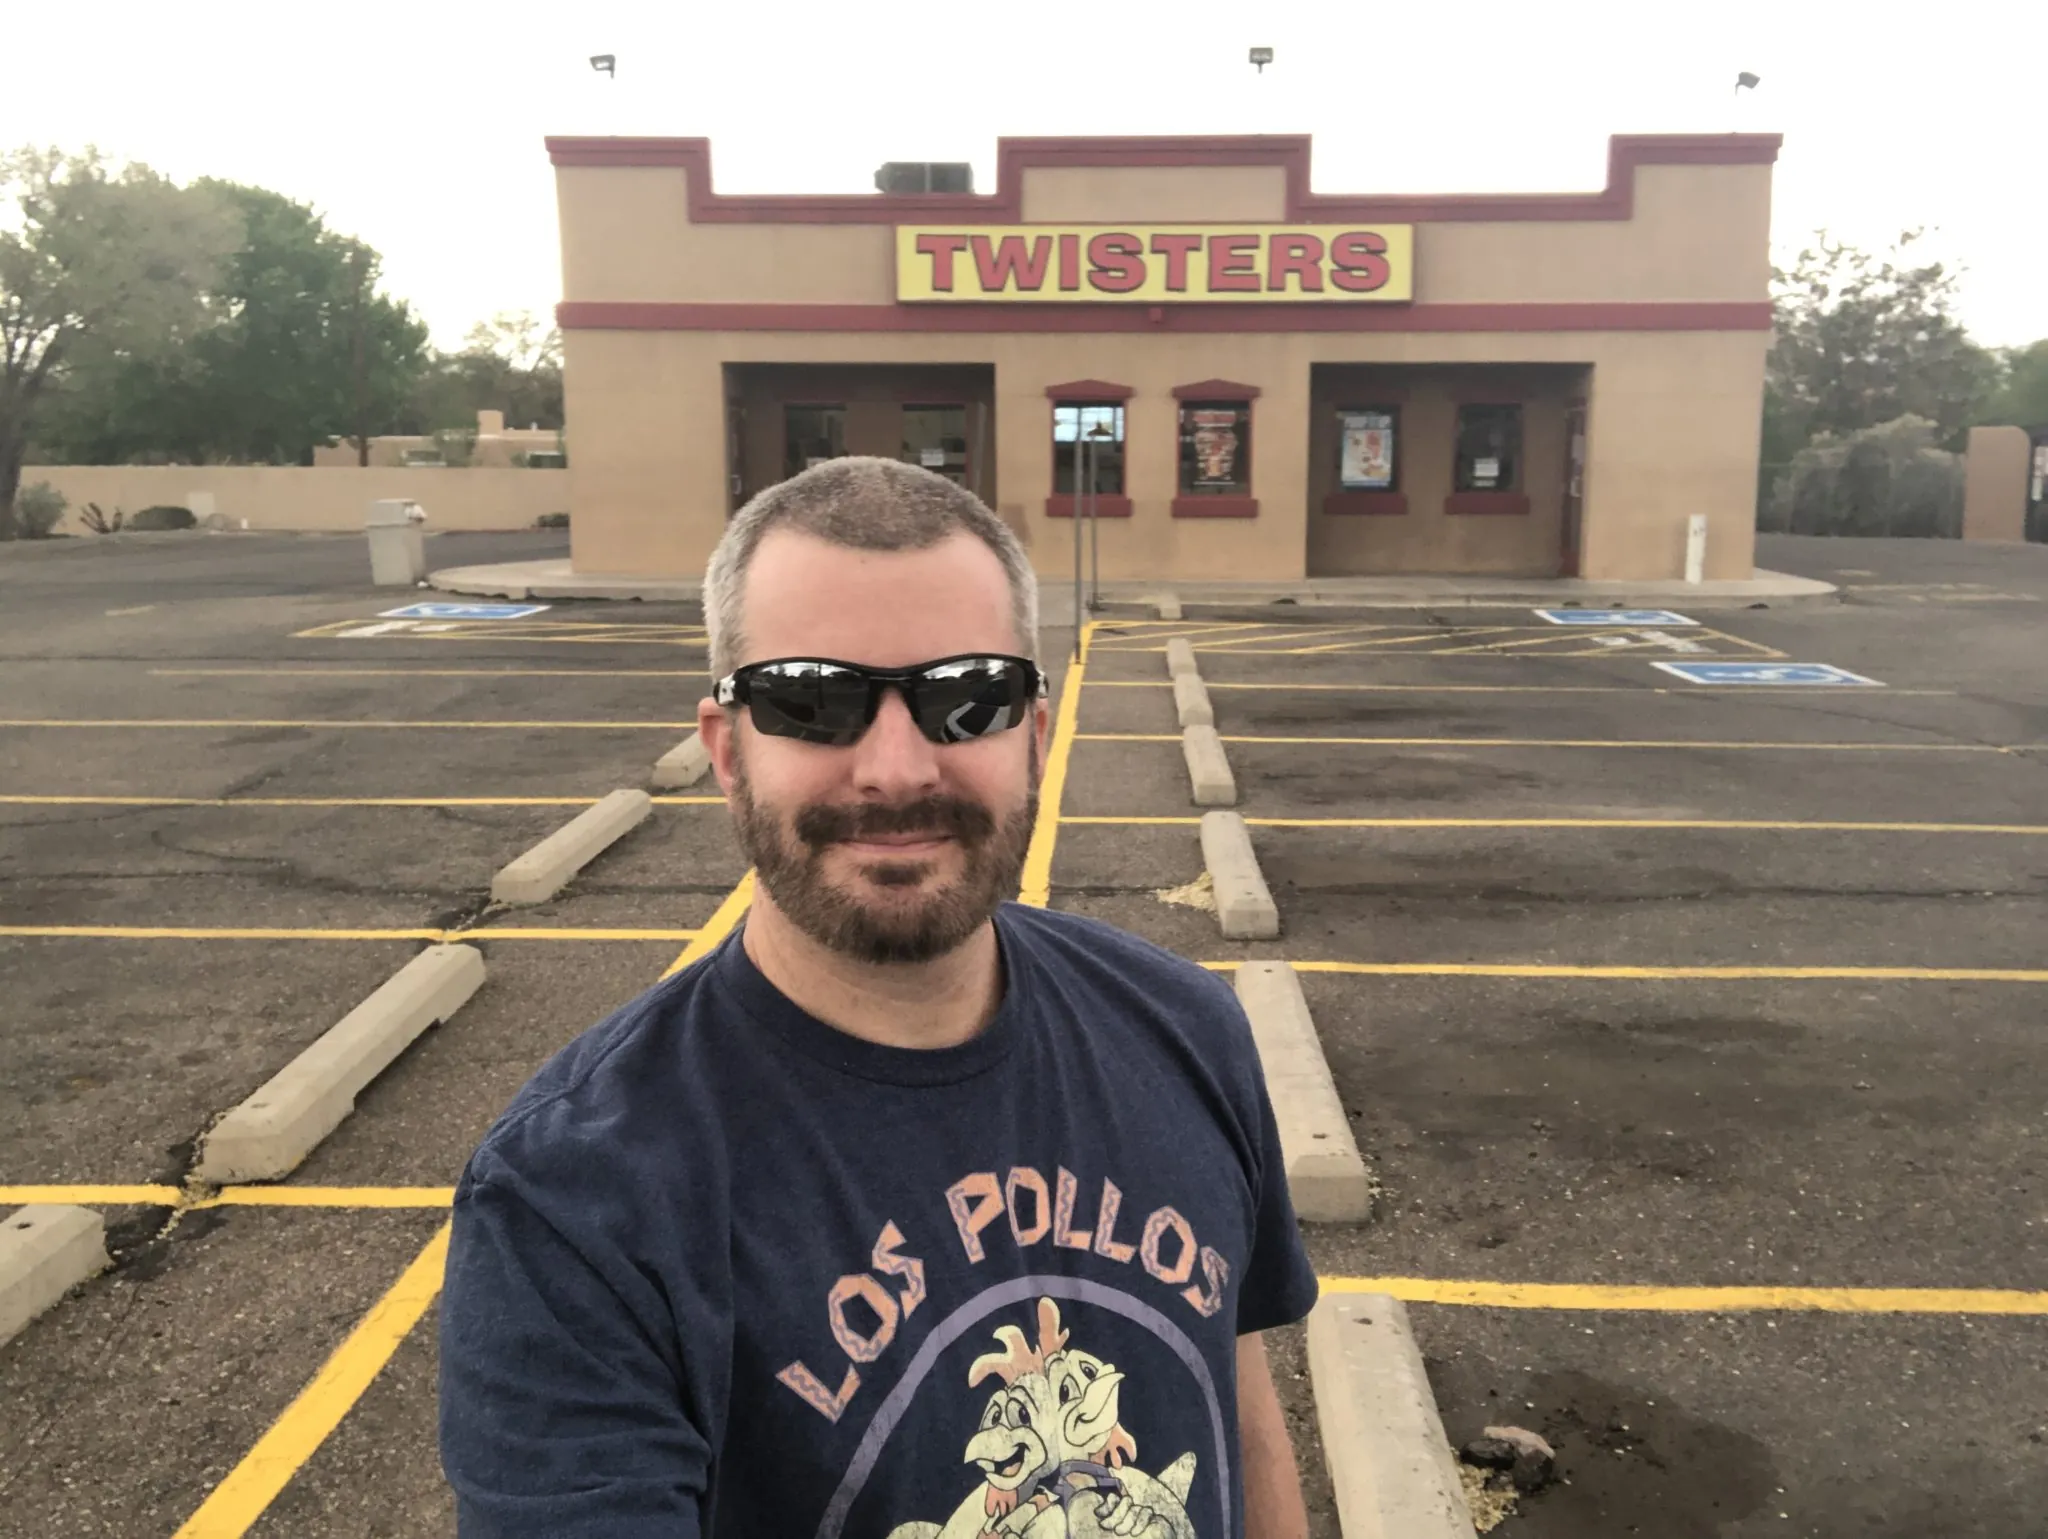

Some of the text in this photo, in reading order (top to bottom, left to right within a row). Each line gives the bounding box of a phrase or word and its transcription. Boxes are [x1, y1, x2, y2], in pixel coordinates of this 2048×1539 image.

[915, 232, 1391, 293] TWISTERS
[776, 1165, 1229, 1423] LOS POLLOS
